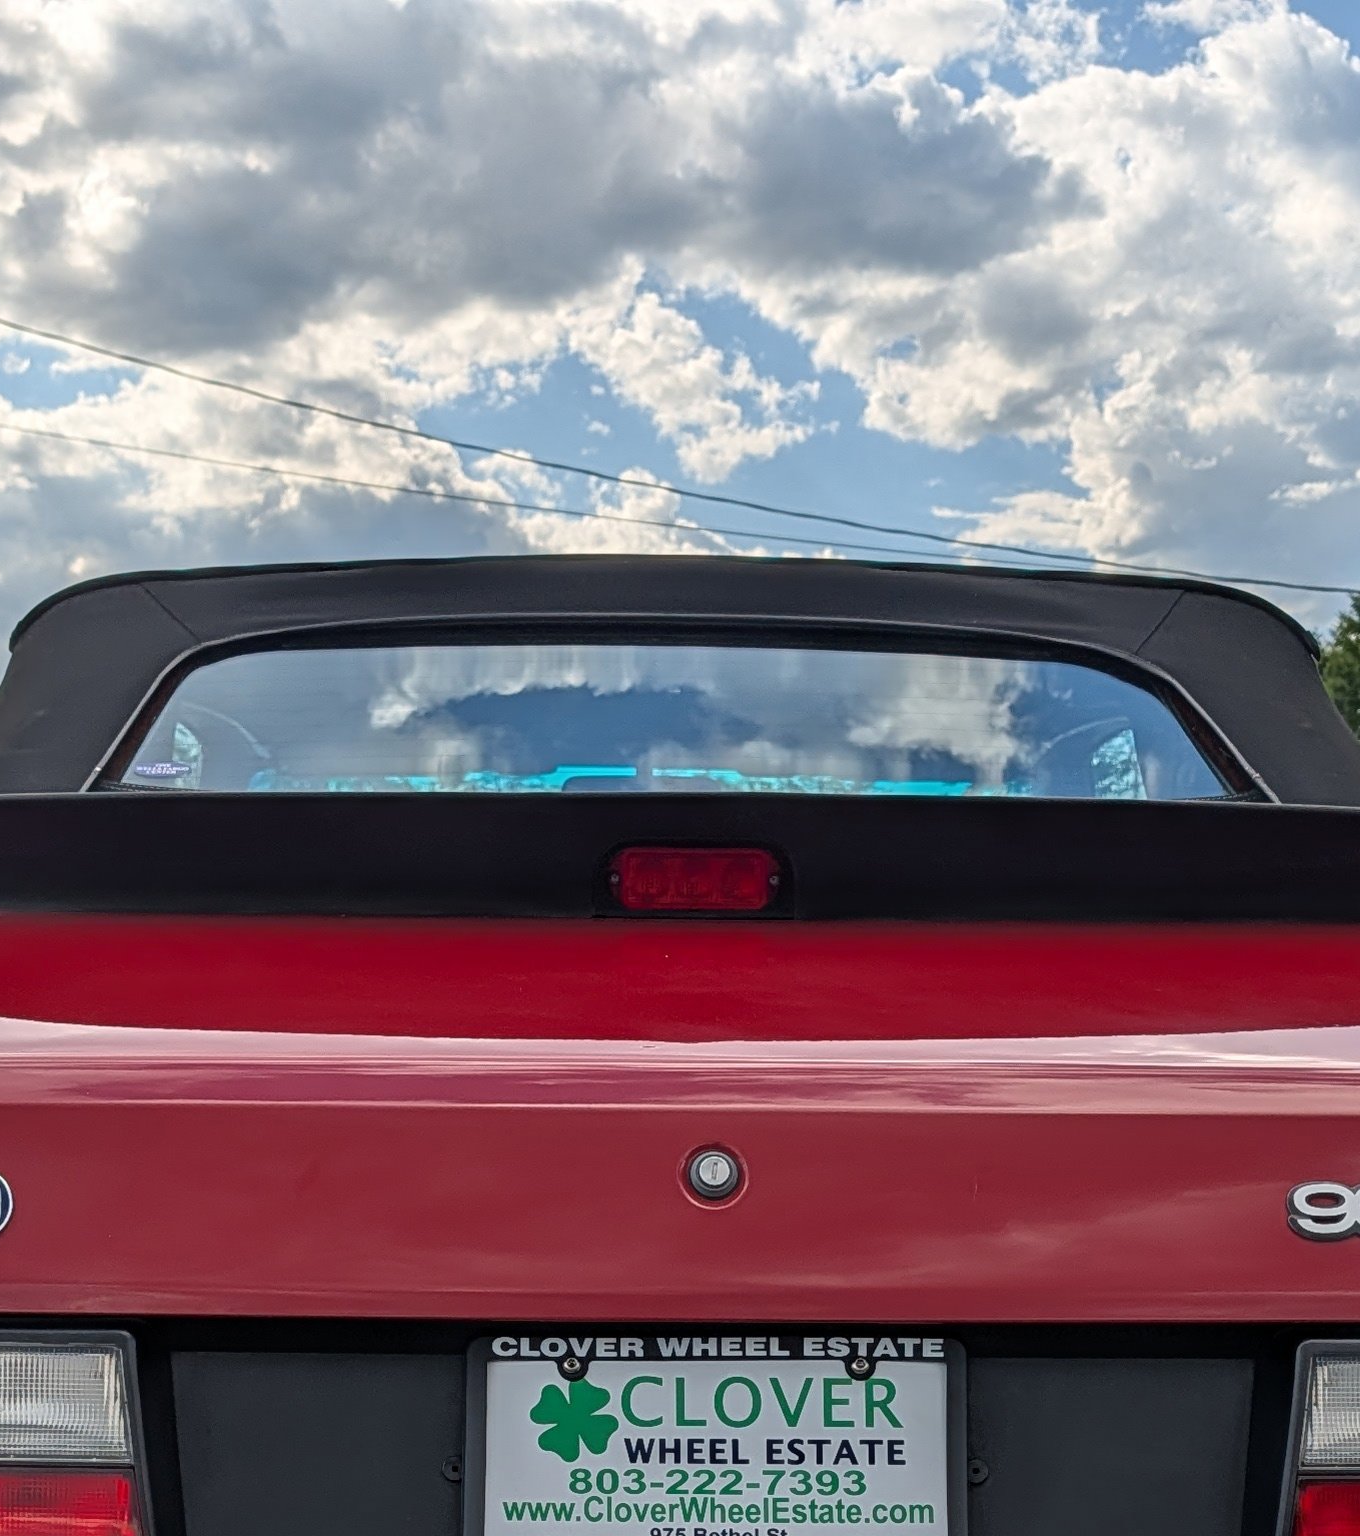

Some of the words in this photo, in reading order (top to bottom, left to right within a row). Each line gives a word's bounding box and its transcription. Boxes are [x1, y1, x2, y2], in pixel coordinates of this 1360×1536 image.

[492, 1337, 644, 1358] CLOVER
[657, 1337, 790, 1358] WHEEL
[803, 1338, 945, 1358] ESTATE
[620, 1375, 904, 1429] CLOVER
[624, 1438, 749, 1465] WHEEL
[767, 1439, 906, 1466] ESTATE
[568, 1468, 868, 1496] 803-222-7393
[502, 1496, 935, 1524] www.CloverWheelEstate.com
